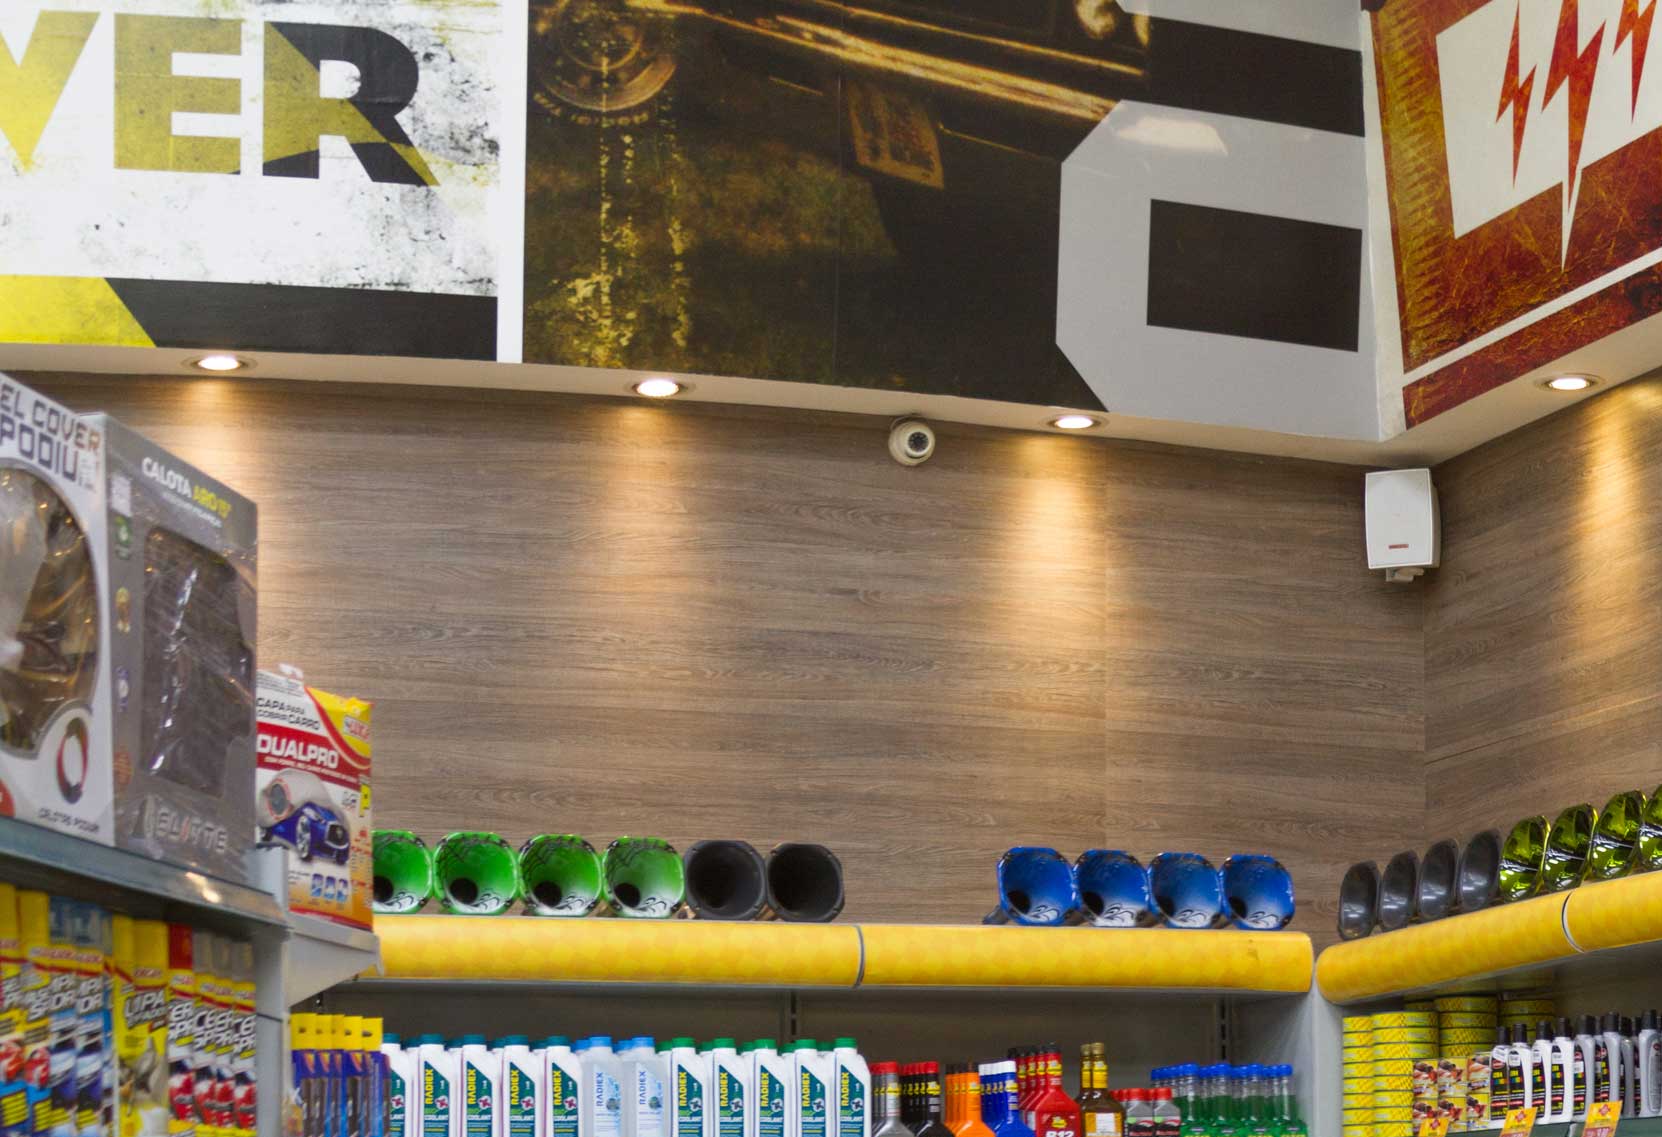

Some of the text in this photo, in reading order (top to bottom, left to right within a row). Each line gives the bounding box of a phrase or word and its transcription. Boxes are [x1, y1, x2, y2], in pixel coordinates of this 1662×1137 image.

[32, 399, 100, 451] COVER
[142, 457, 192, 498] CALOTA
[257, 734, 339, 769] DUALPRO
[424, 1068, 434, 1104] RADIEX
[467, 1068, 476, 1104] RADIEX
[553, 1070, 562, 1105] RADIEX
[596, 1071, 604, 1107] RADIEX
[678, 1071, 687, 1107] RADIEX
[719, 1072, 728, 1107] RADIEX
[801, 1072, 810, 1107] RADIEX
[840, 1071, 849, 1106] RADIEX
